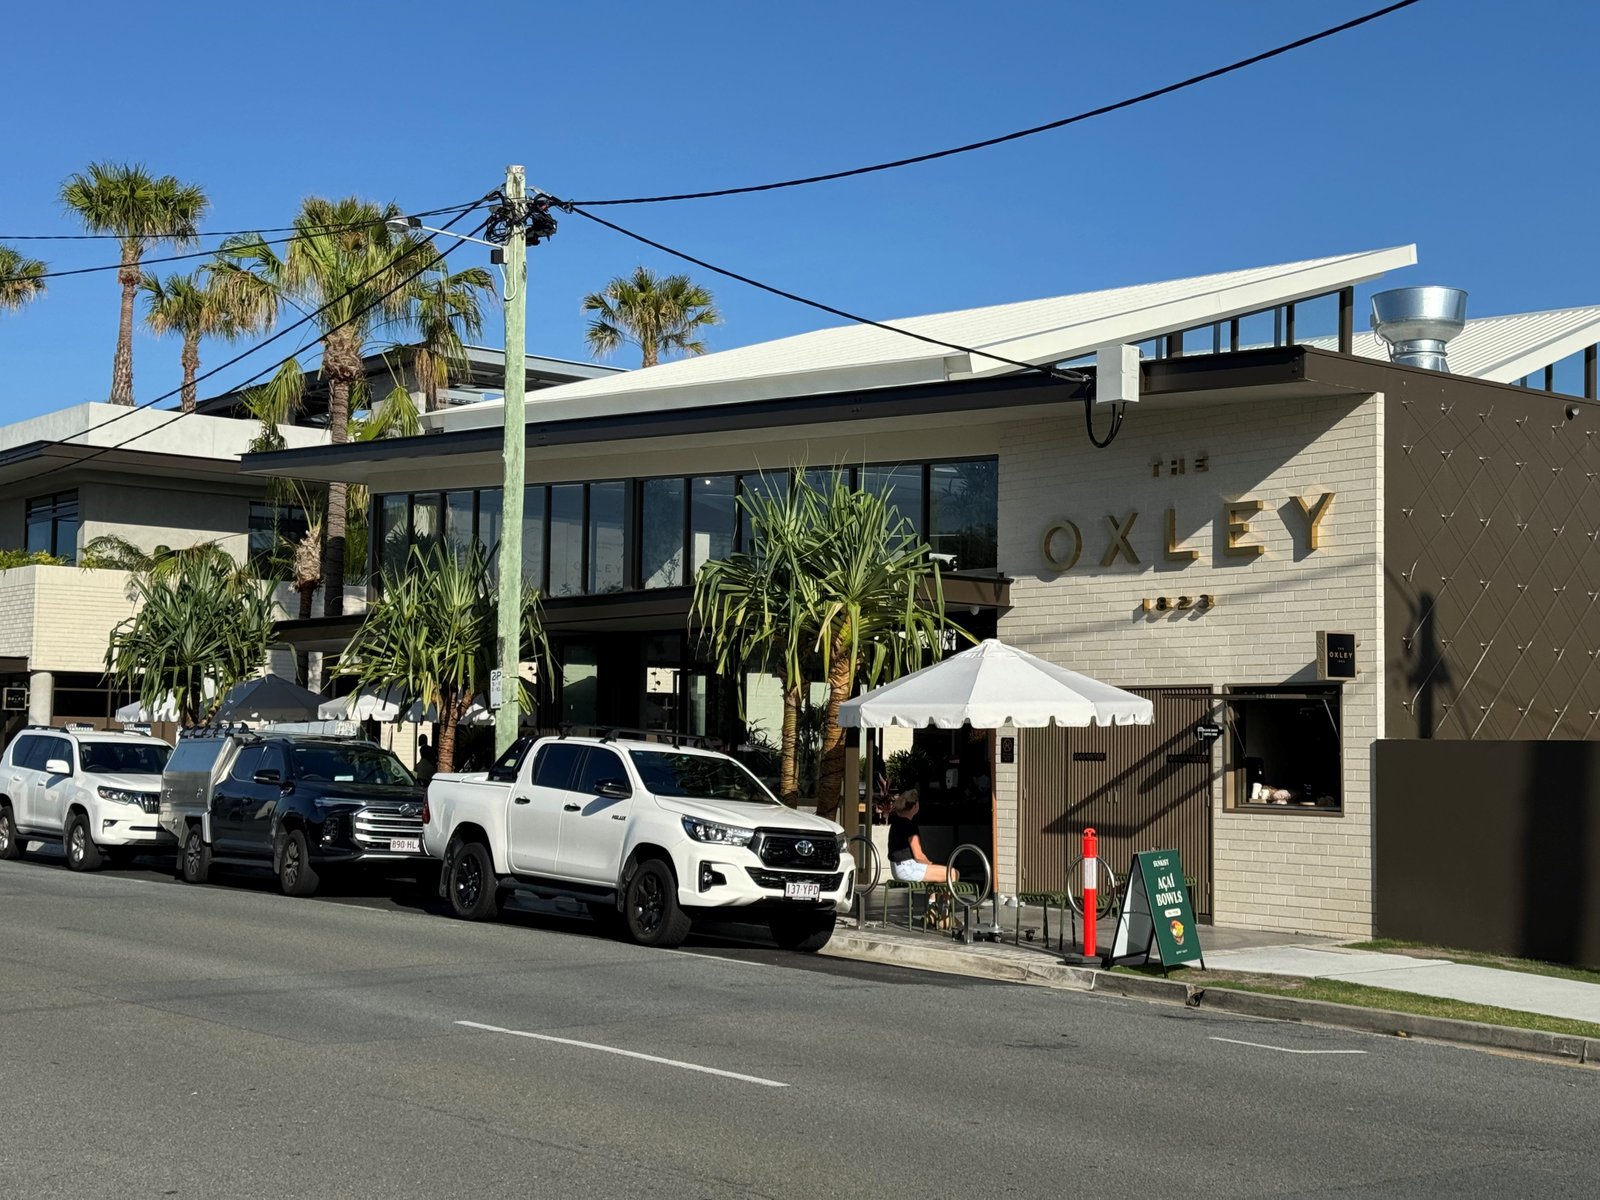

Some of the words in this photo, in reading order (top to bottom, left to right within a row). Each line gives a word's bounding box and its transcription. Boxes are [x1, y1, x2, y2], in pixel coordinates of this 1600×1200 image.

[1151, 455, 1210, 477] THE
[1042, 492, 1335, 572] OXLEY
[1141, 594, 1216, 613] 1823
[1329, 651, 1353, 659] OXLEY
[491, 671, 503, 681] 2P
[787, 884, 801, 894] 137
[803, 884, 818, 895] YPD
[1157, 873, 1175, 892] AÇAÍ
[1155, 891, 1183, 907] BOWLS
